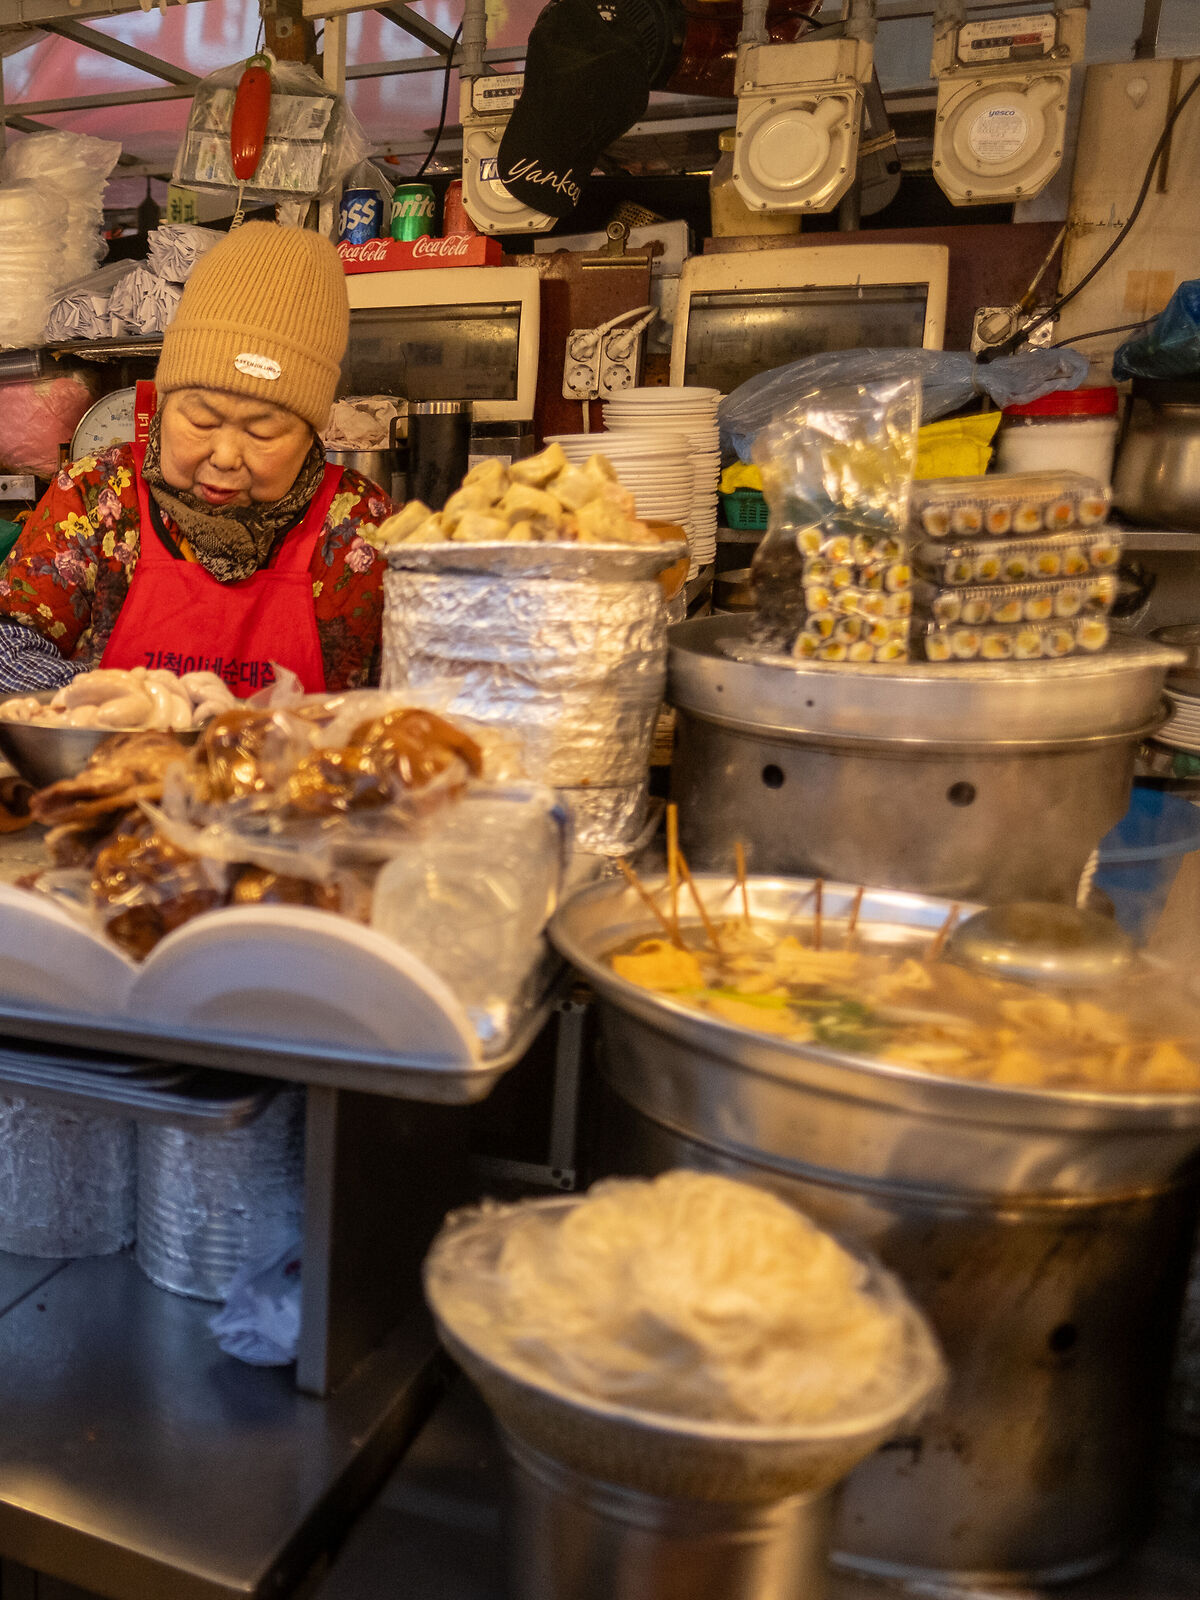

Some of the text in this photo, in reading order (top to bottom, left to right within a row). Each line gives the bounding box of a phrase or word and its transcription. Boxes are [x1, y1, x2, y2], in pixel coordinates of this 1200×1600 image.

[988, 110, 1016, 118] yesco
[390, 193, 436, 224] prite
[412, 235, 472, 258] Coca-Cola
